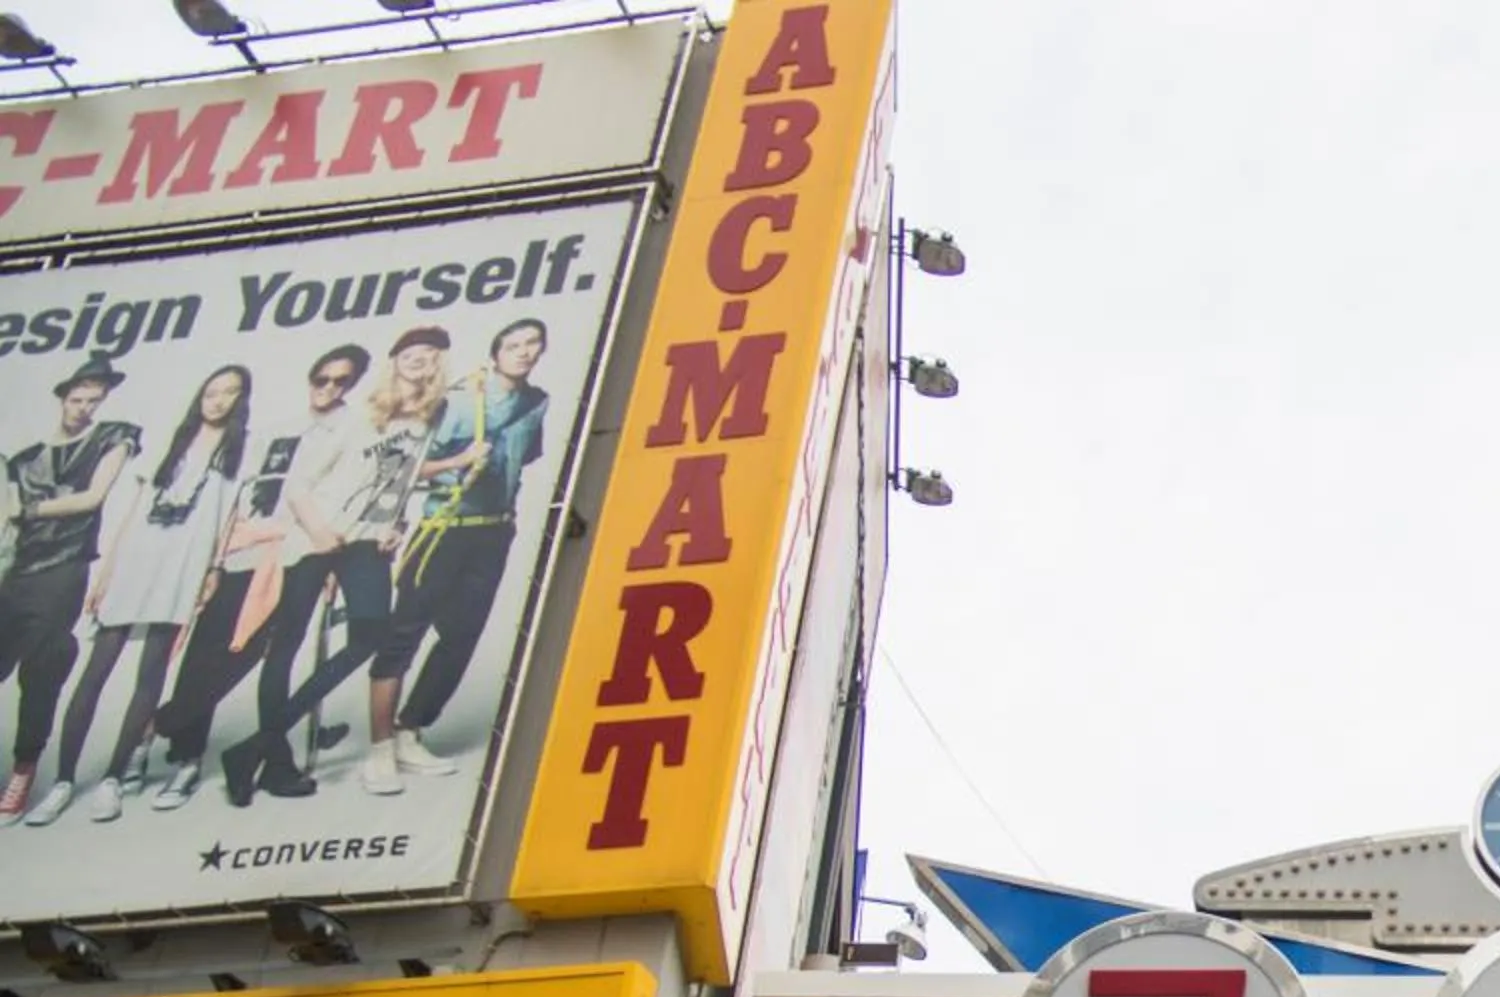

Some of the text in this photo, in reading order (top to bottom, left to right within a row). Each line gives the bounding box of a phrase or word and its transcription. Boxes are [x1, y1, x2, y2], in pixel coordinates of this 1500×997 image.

[236, 234, 596, 334] Yourself.
[582, 4, 836, 851] ABC-MART
[231, 833, 410, 869] CONVERSE
